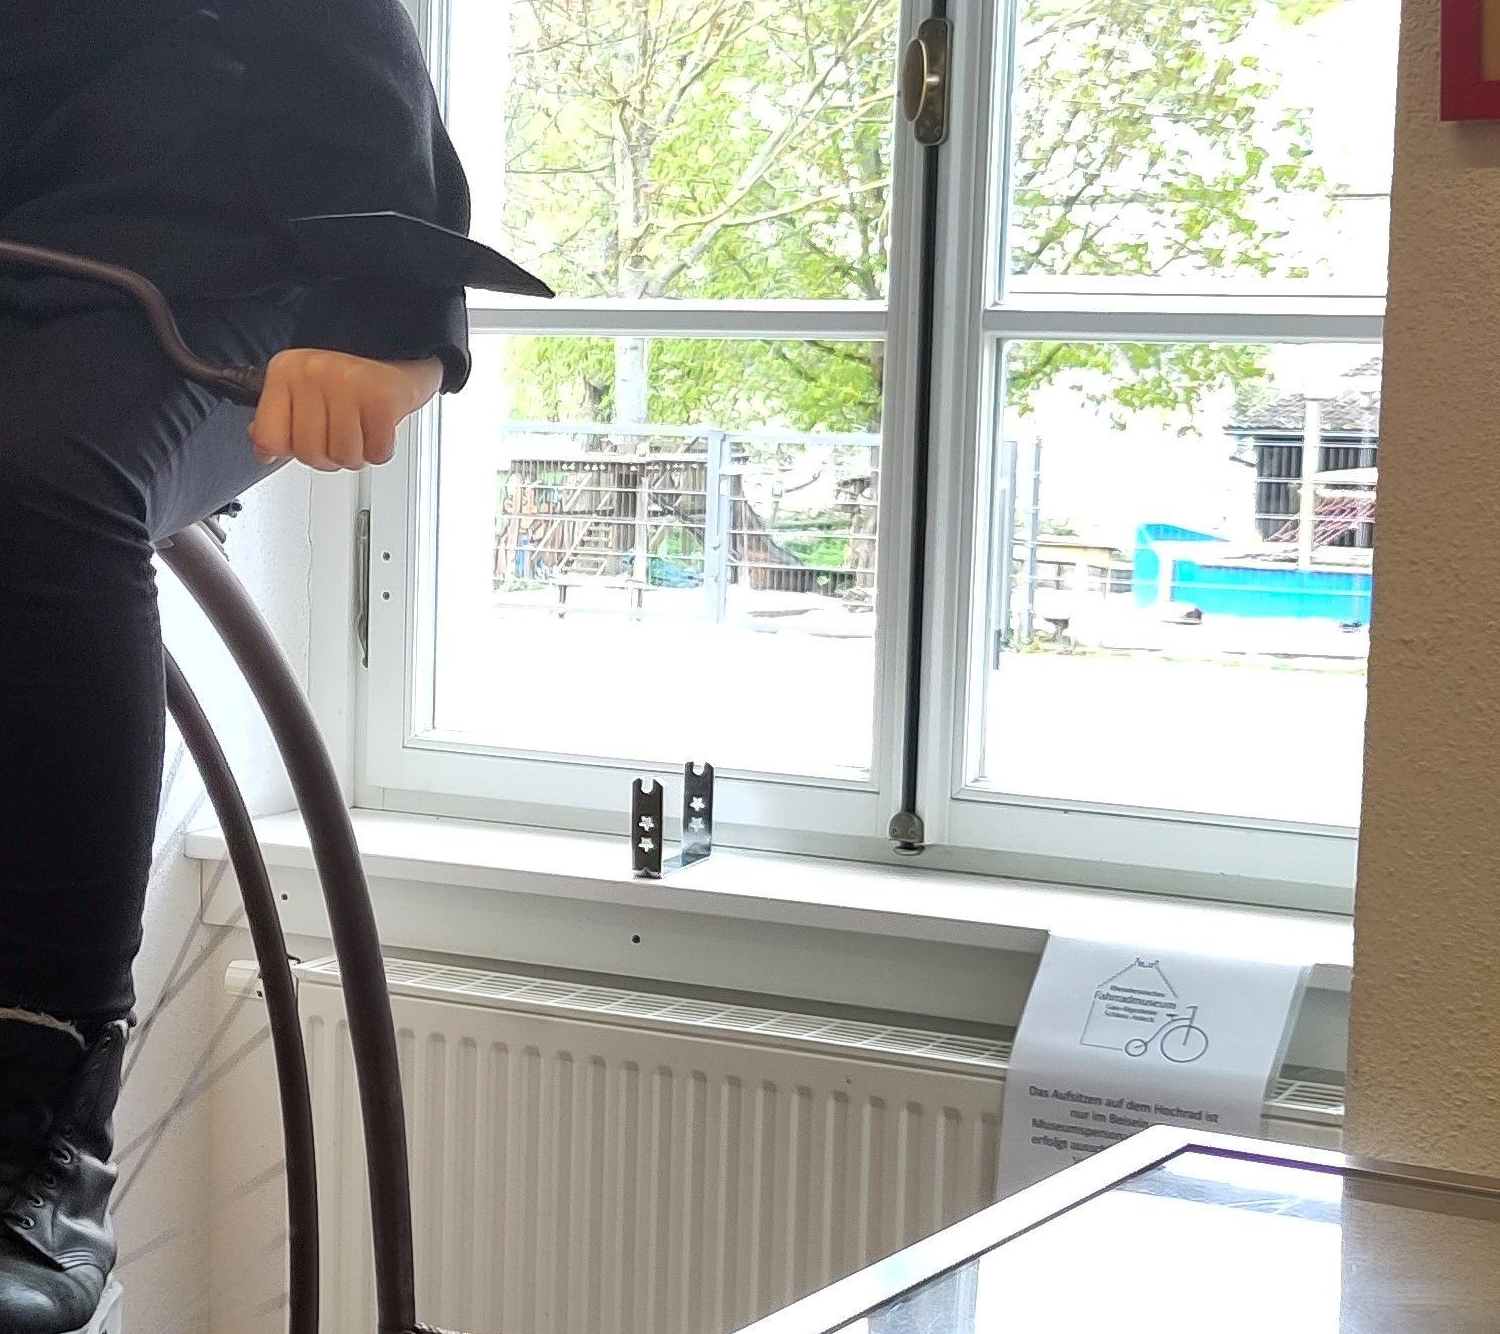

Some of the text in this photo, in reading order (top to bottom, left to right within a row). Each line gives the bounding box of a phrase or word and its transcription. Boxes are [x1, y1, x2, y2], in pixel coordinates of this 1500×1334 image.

[1028, 1085, 1049, 1098] Das
[1050, 1089, 1103, 1106] Aufsitzen
[1105, 1097, 1124, 1108] auf
[1125, 1099, 1151, 1113] dem
[1154, 1104, 1203, 1121] Hochrad
